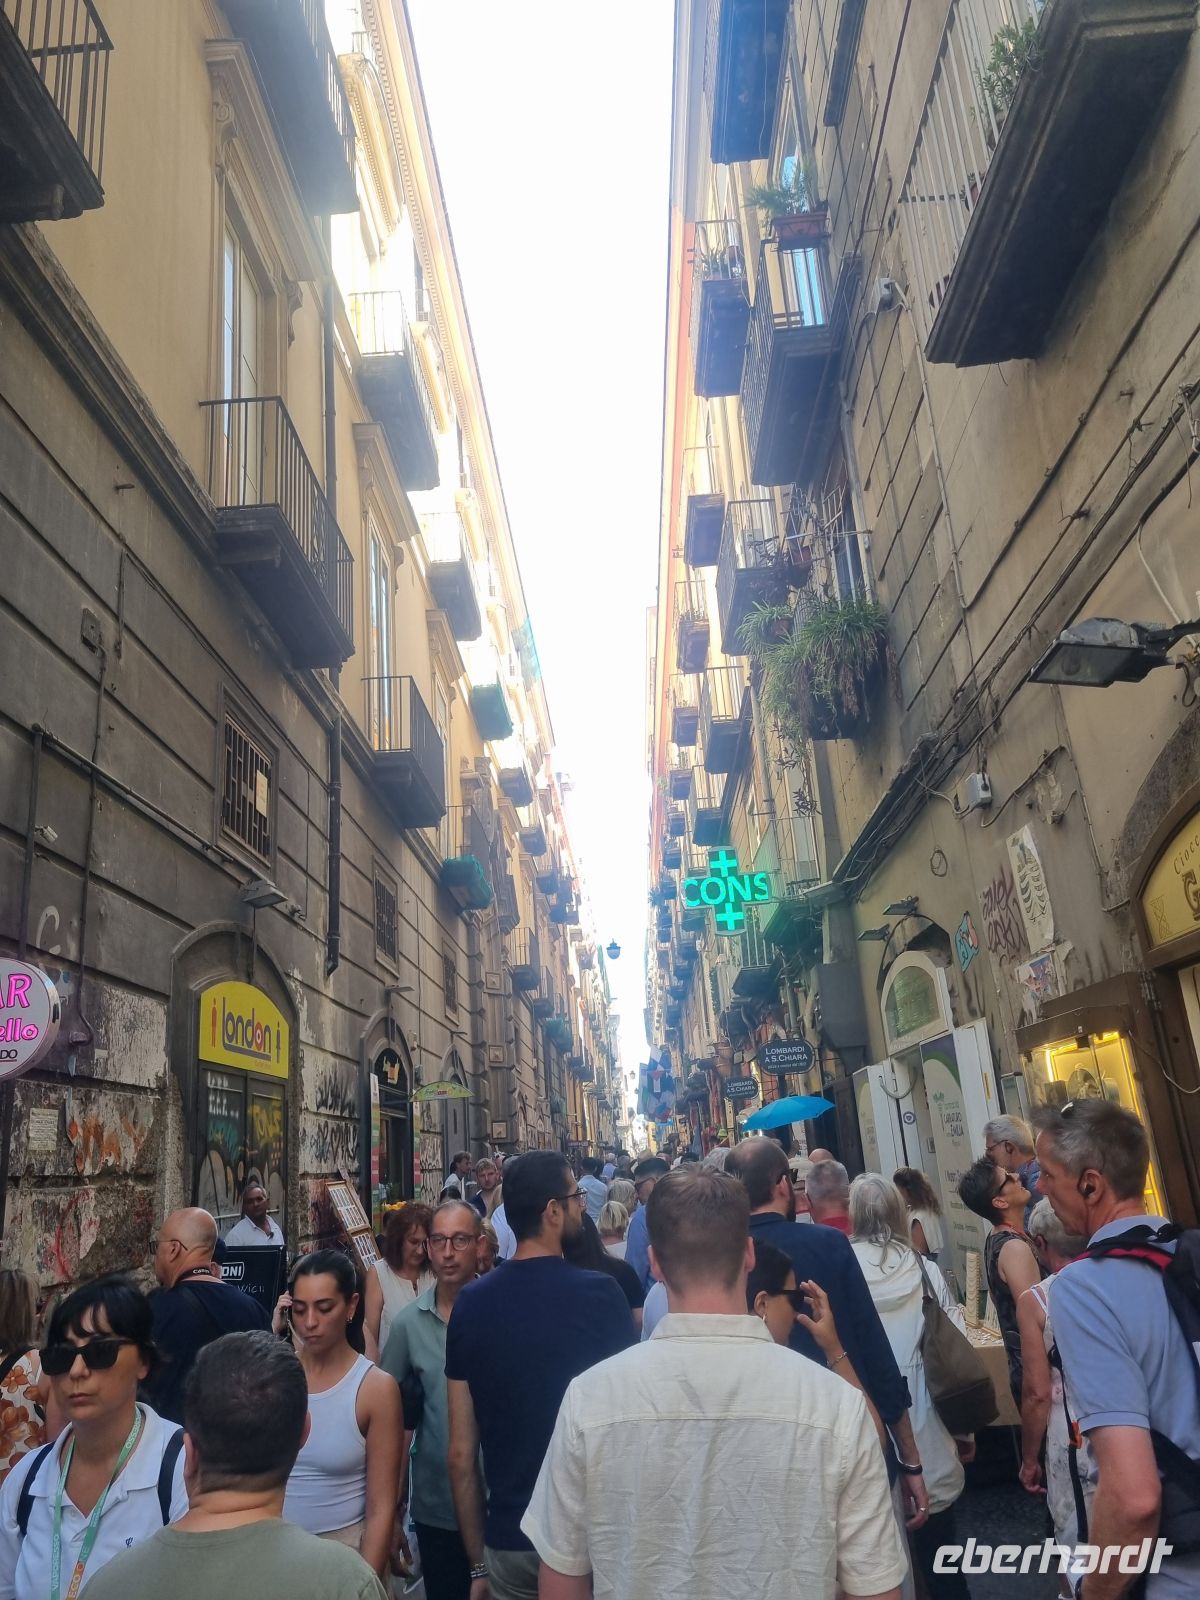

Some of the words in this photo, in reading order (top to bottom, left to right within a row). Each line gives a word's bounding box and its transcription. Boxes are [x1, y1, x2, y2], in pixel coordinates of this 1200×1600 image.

[683, 872, 769, 907] CONS
[222, 997, 272, 1061] london
[765, 1046, 805, 1055] LOMBARDI
